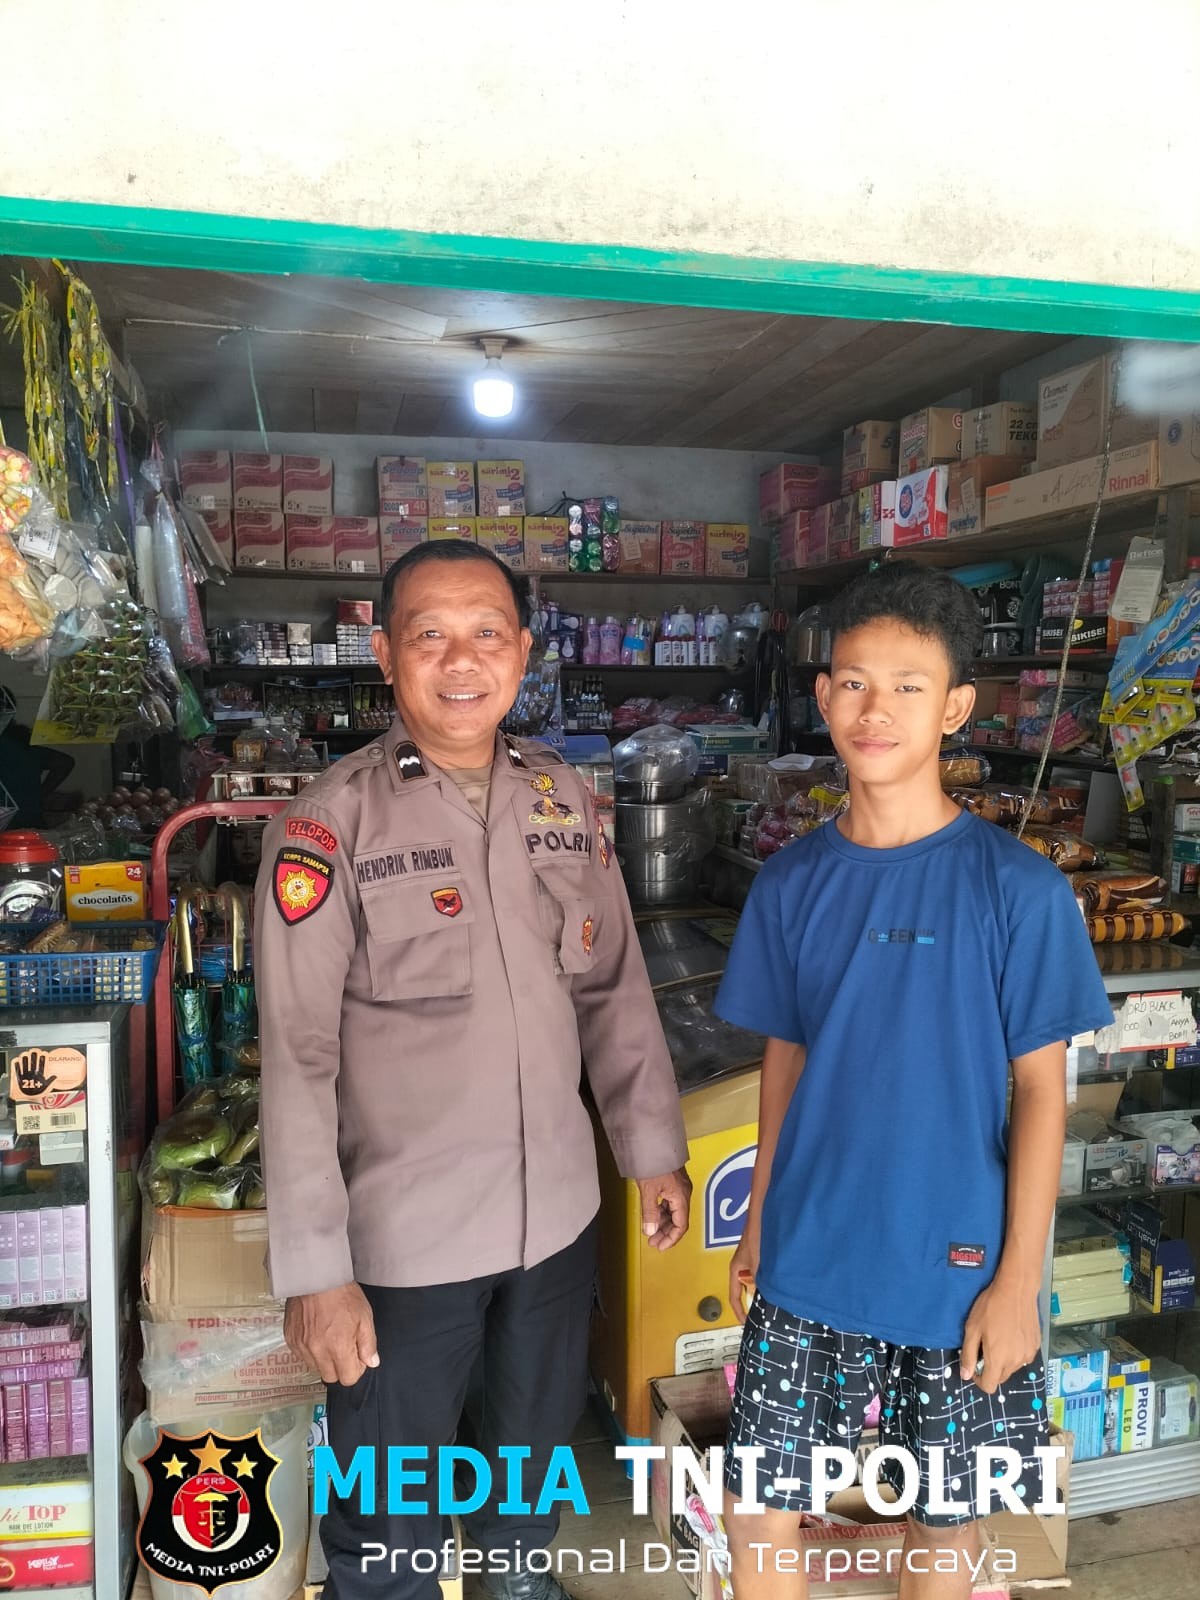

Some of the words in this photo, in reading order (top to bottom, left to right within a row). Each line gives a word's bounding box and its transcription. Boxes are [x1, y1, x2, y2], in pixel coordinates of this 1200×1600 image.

[1009, 420, 1024, 430] 22
[1108, 469, 1149, 492] Rinnai
[290, 822, 335, 850] PELOPOR
[525, 831, 591, 855] POLRI
[128, 867, 142, 876] 24
[356, 853, 408, 884] HENDRIK
[1150, 1001, 1176, 1012] BLACK
[22, 1080, 43, 1088] 21+
[240, 1368, 266, 1377] SUPER
[268, 1365, 304, 1376] QUALITY
[1123, 1408, 1132, 1434] LED
